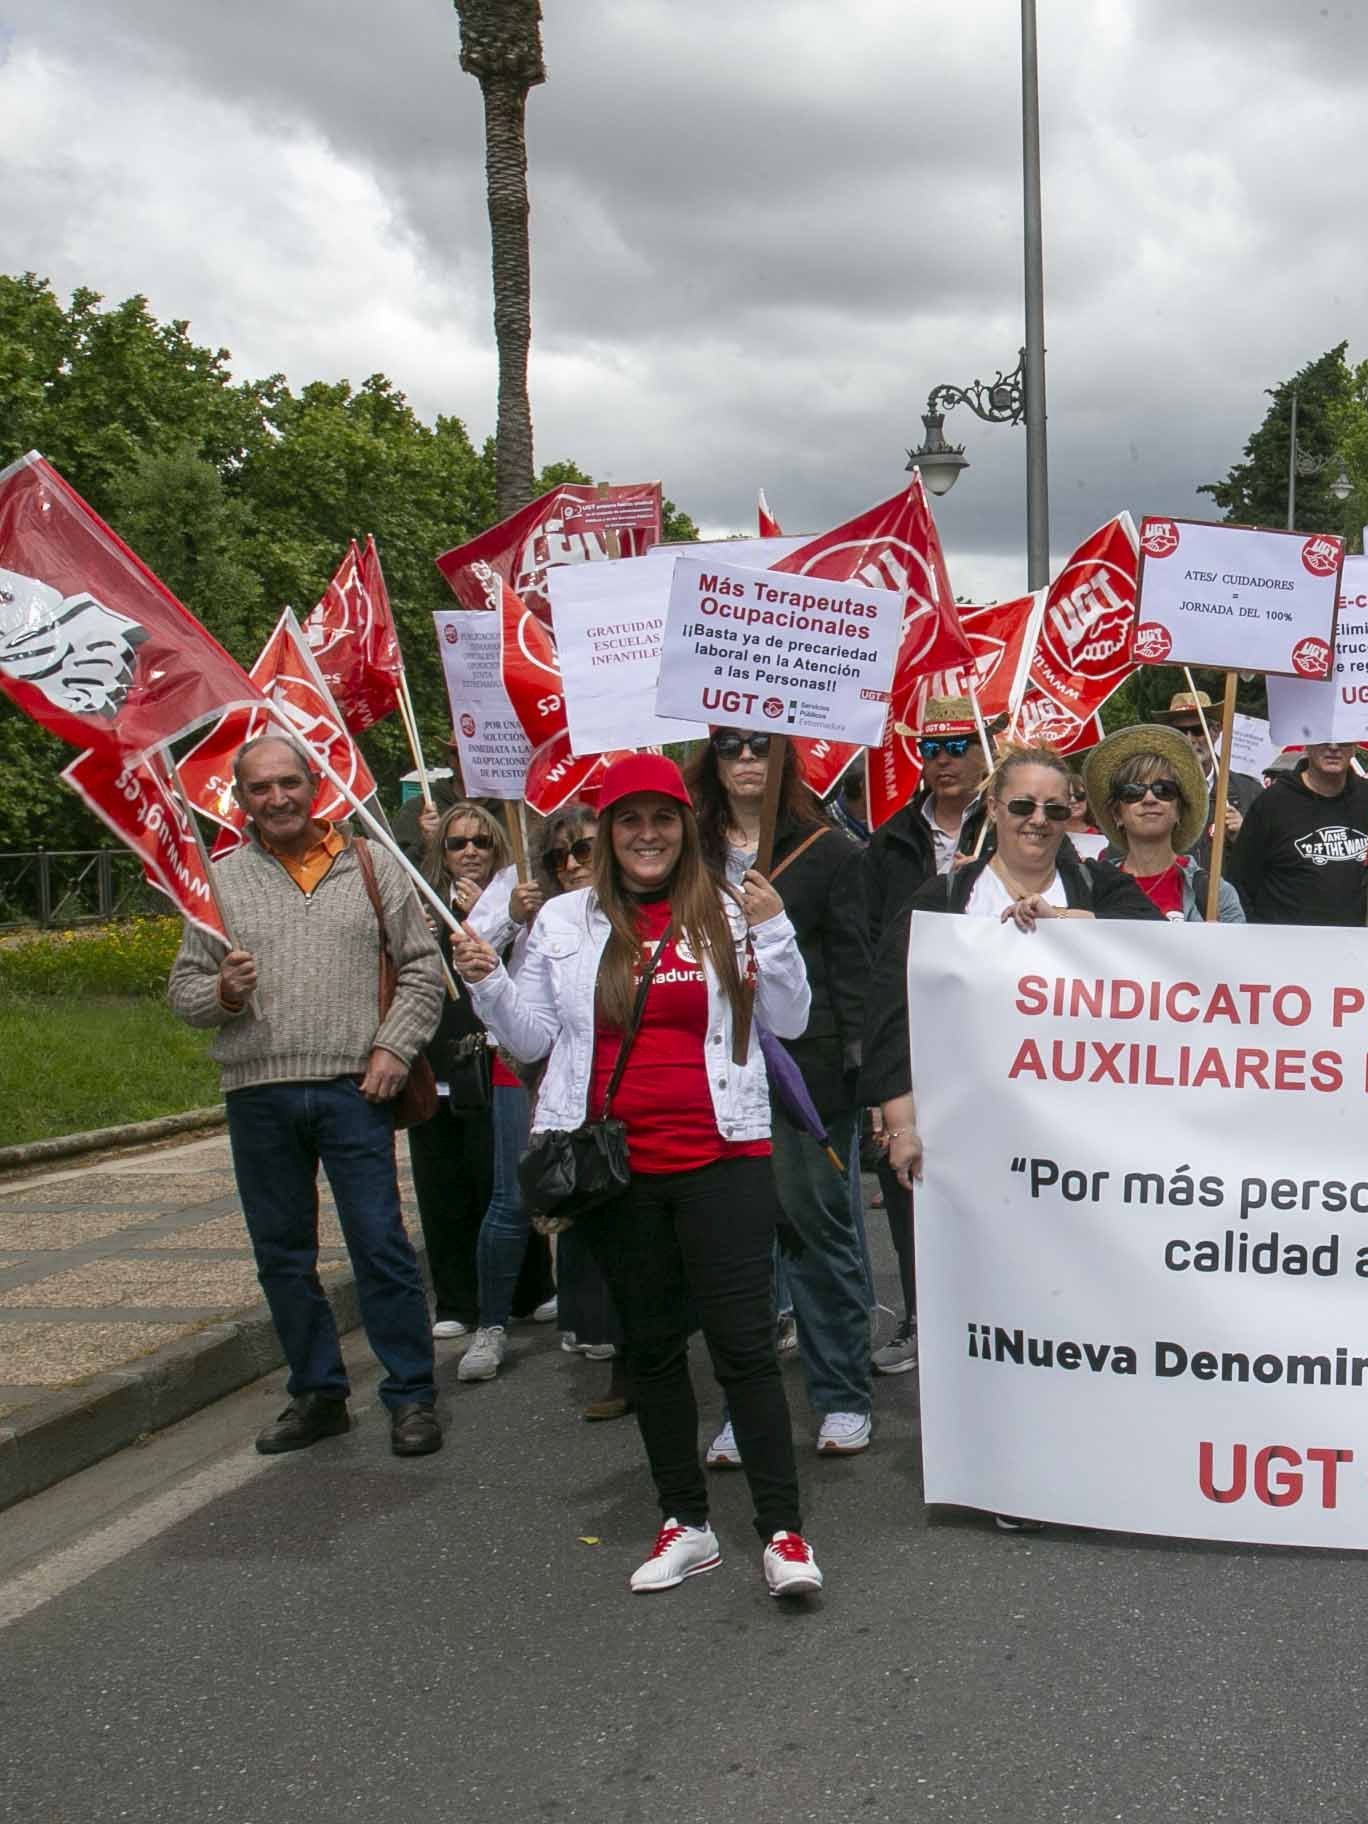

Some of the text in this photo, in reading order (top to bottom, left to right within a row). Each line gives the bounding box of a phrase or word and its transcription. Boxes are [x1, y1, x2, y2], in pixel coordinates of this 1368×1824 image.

[1145, 523, 1171, 537] UGT
[1313, 538, 1339, 559] UGT
[1184, 569, 1295, 591] ATES/ CUIDADORES
[698, 574, 878, 619] Más Terapeutas
[1049, 567, 1131, 648] UGT
[700, 597, 870, 639] Ocupacionales
[1179, 601, 1293, 622] JORNADA DEL 100%
[586, 618, 663, 639] GRATUIDAD
[594, 633, 661, 651] ESCUELAS
[1137, 628, 1162, 642] UGT
[694, 642, 861, 678] laboral en la Atención
[742, 633, 760, 647] ya
[766, 632, 784, 648] de
[789, 639, 878, 663] precariedad
[1301, 642, 1328, 661] UGT
[714, 665, 837, 693] a las Personas!!
[1337, 663, 1344, 673] e
[702, 687, 759, 715] UGT
[1319, 829, 1348, 843] VANS
[1323, 841, 1346, 857] THE
[1015, 974, 1312, 1027] SINDICATO
[1008, 1038, 1344, 1092] AUXILIARES
[1011, 1157, 1109, 1202] “Por
[1123, 1163, 1225, 1207] más
[1164, 1230, 1339, 1276] calidad
[968, 1322, 1137, 1375] ¡¡Nueva
[1198, 1441, 1354, 1509] UGT
